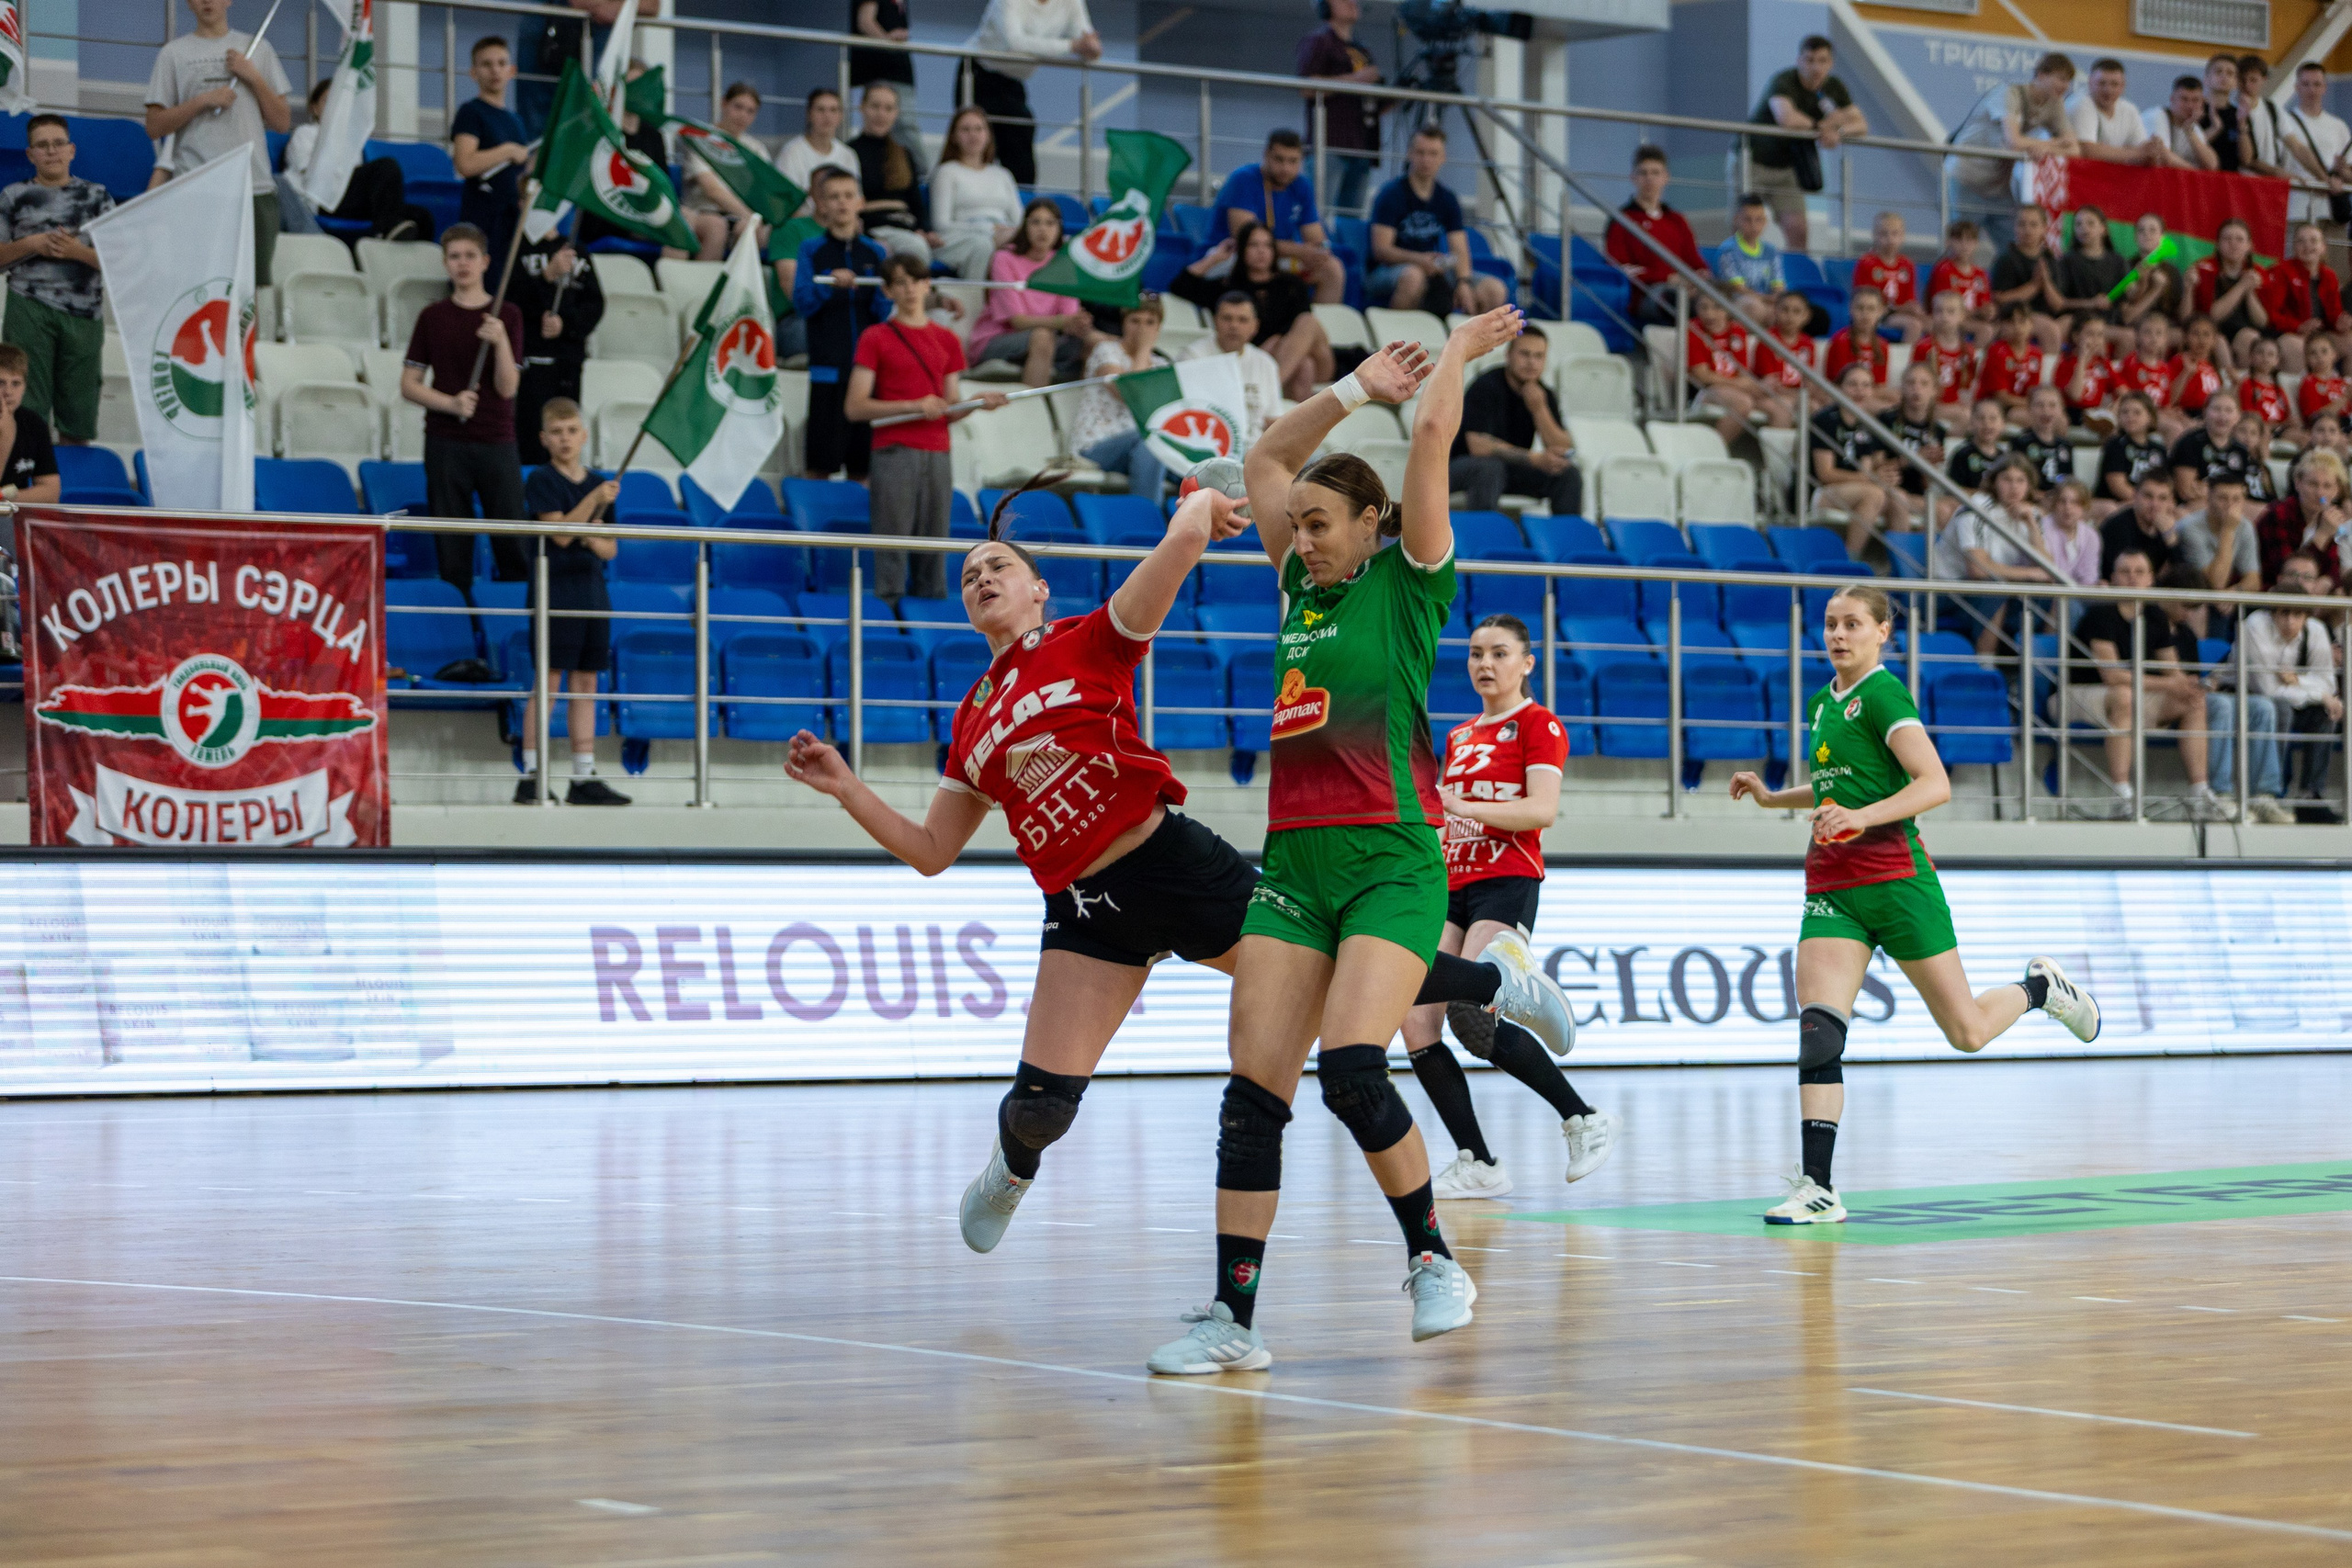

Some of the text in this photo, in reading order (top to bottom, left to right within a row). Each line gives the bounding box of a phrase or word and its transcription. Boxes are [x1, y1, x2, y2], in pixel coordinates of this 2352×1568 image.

[1925, 39, 2041, 73] ТРИБУН
[42, 560, 368, 663] КОЛЕРЫ СЭРЦА
[1281, 624, 1338, 644] МЕЛЬСКИЙ
[1286, 646, 1310, 660] ДСК
[965, 678, 1081, 789] BELAZ
[1446, 743, 1497, 778] 23
[1019, 751, 1119, 852] БНТУ
[1444, 780, 1521, 801] LAZ
[124, 787, 304, 843] КОЛЕРЫ
[1071, 803, 1105, 836] 1920
